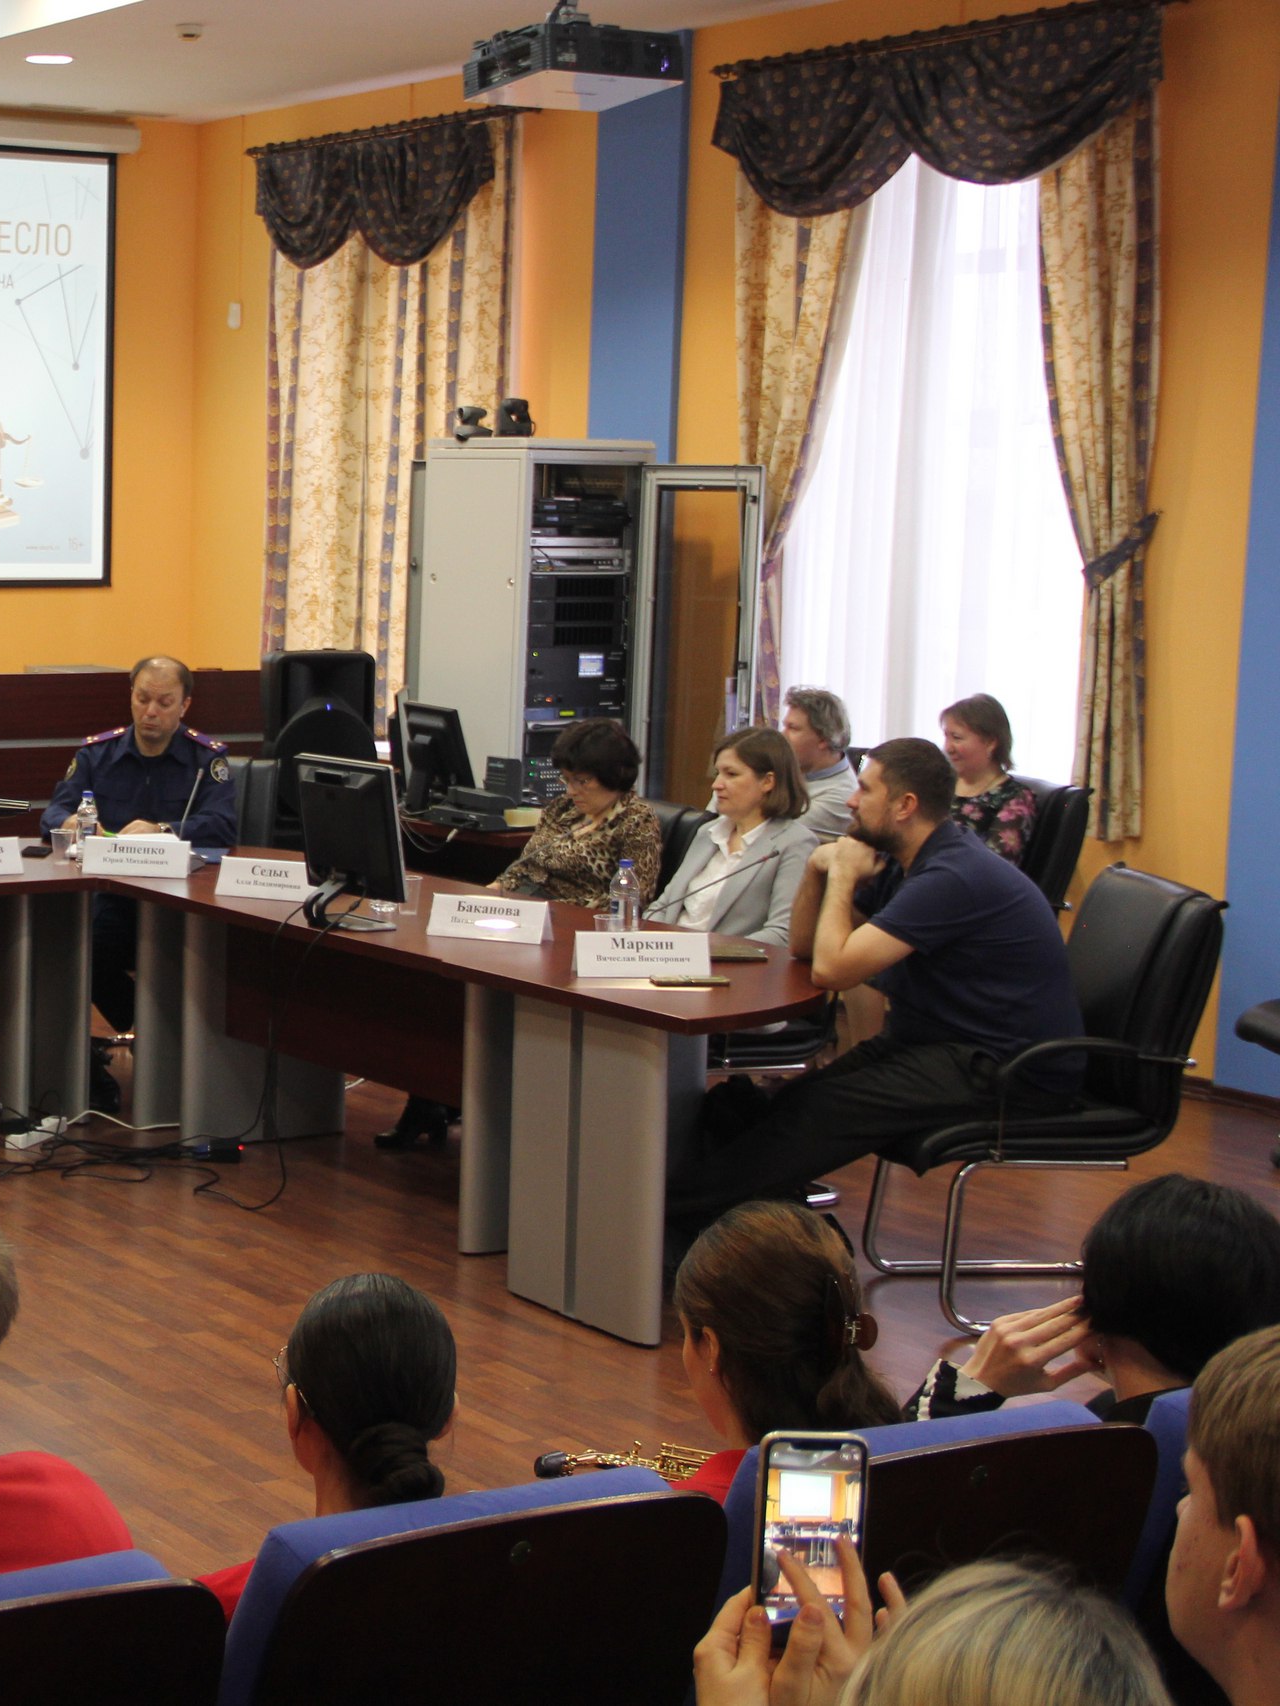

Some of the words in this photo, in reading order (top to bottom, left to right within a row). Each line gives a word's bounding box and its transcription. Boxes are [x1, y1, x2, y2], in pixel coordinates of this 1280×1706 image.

[251, 864, 290, 879] Седых
[456, 900, 521, 917] Баканова
[611, 937, 674, 953] Маркин
[596, 954, 636, 962] Вячеслав
[638, 955, 691, 964] Викторович
